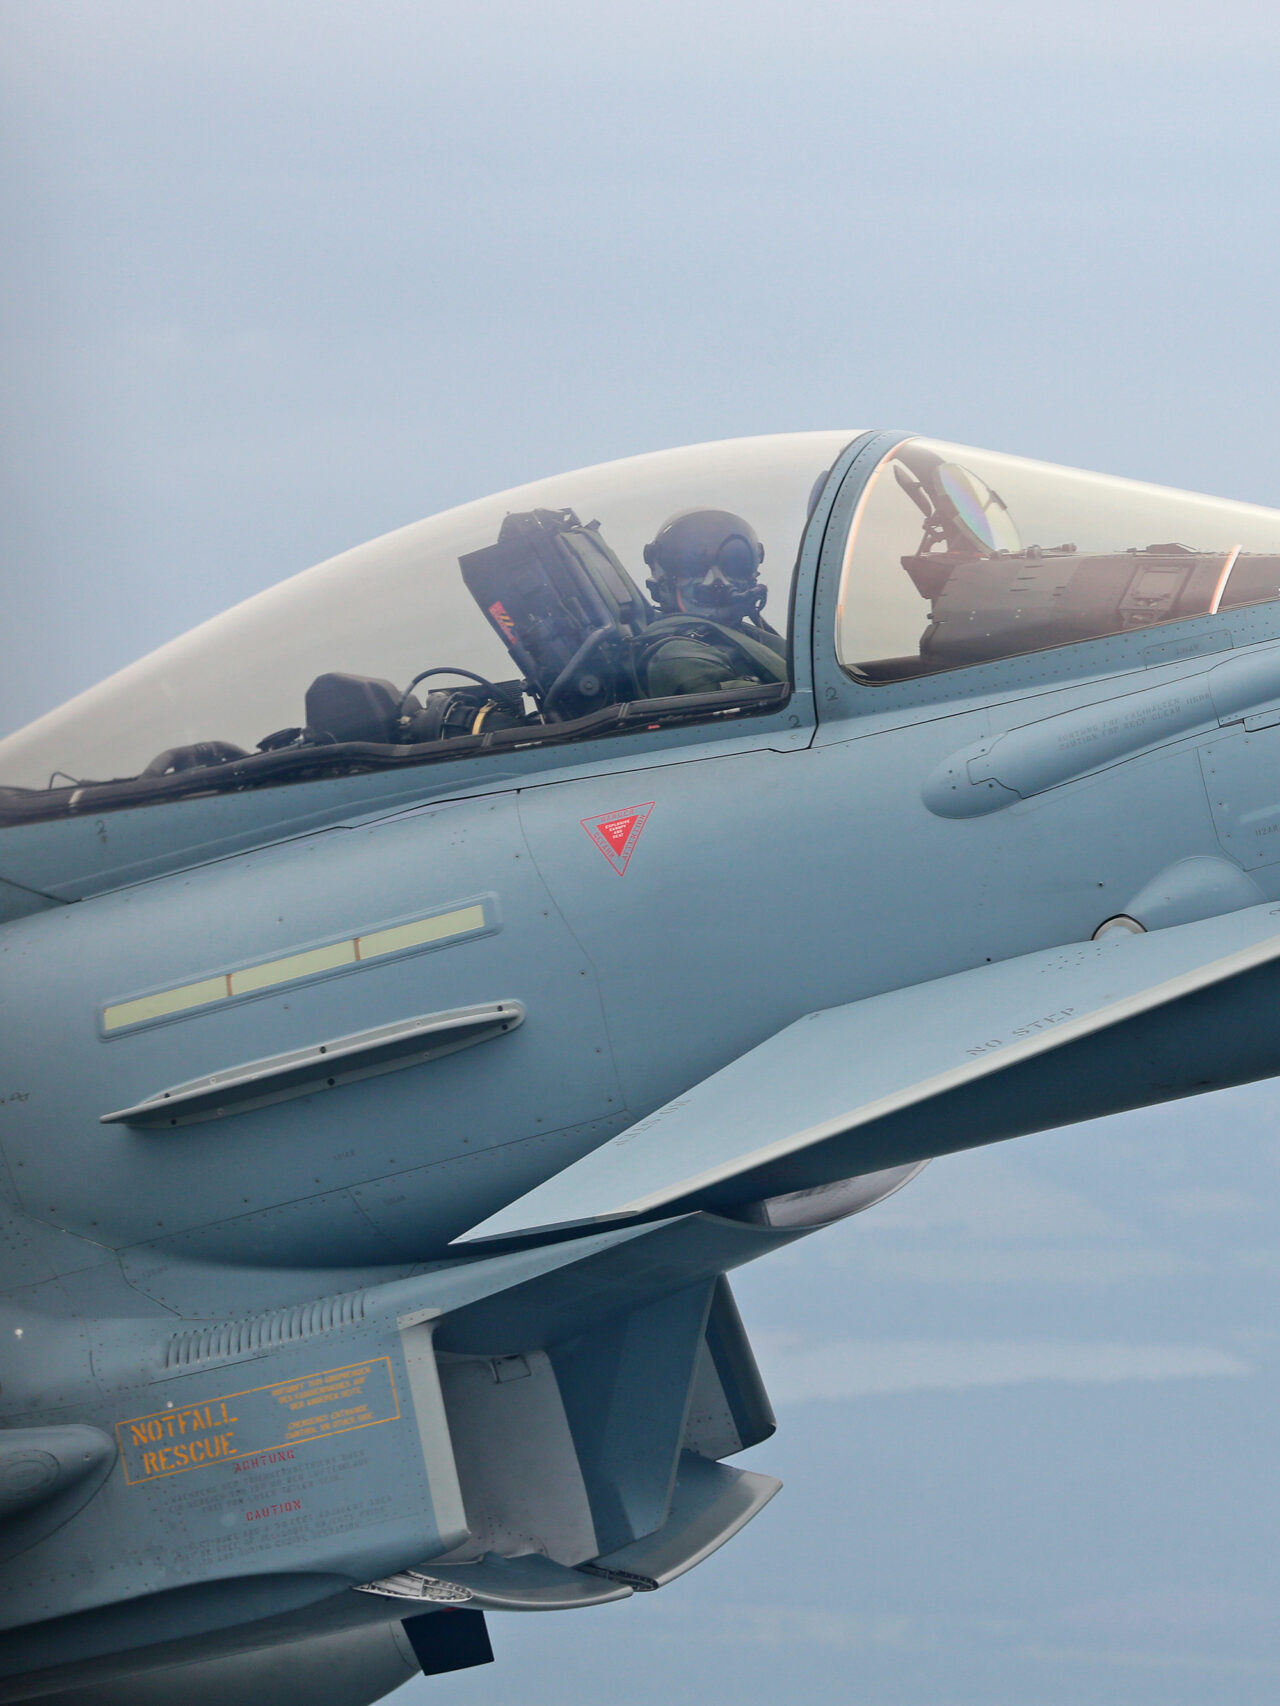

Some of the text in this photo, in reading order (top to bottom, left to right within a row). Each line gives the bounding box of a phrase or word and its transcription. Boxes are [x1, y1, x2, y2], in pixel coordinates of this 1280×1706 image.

[965, 1007, 1074, 1056] NO STEP
[130, 1402, 239, 1446] NOTFALL
[142, 1431, 239, 1476] RESCUE
[233, 1449, 296, 1473] ACHTUNG
[245, 1499, 302, 1522] CAUTION
